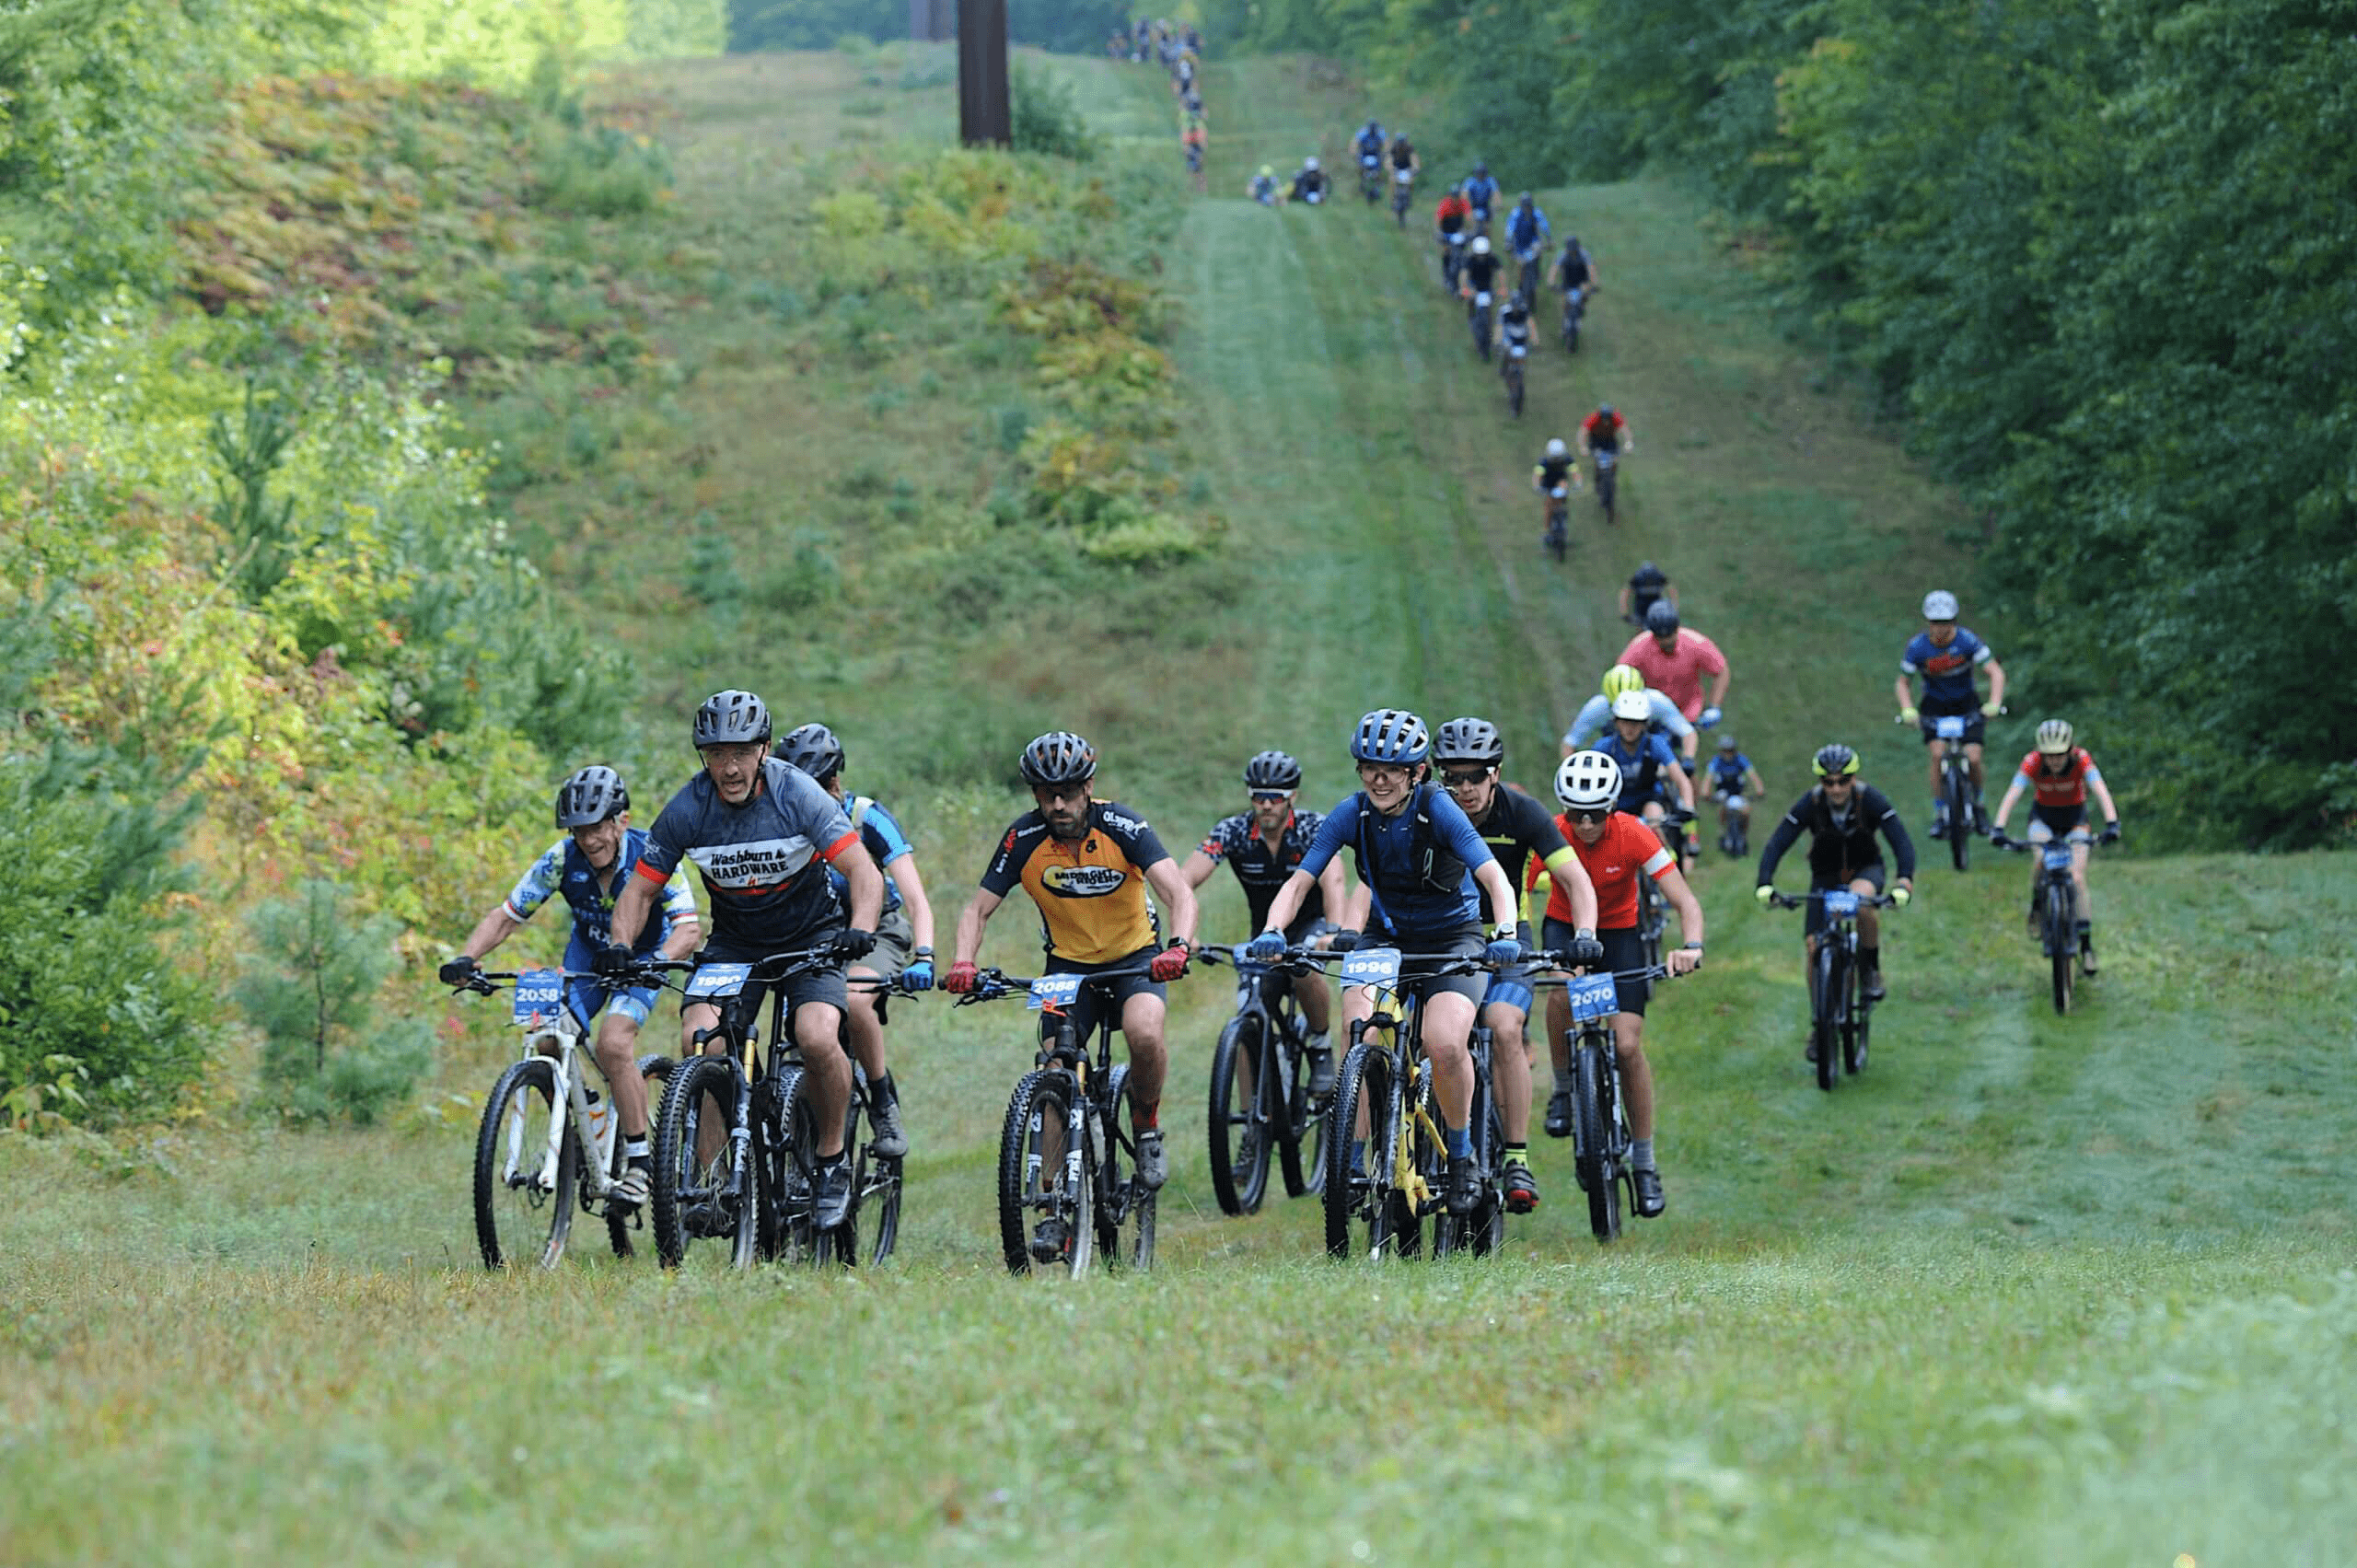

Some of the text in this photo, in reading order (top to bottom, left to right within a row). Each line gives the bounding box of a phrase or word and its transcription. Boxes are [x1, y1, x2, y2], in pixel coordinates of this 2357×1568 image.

[711, 849, 772, 865] Washburn
[711, 861, 788, 878] HARDWARE
[1348, 961, 1392, 974] 1996
[517, 988, 559, 1002] 2058
[1571, 987, 1613, 1007] 2070
